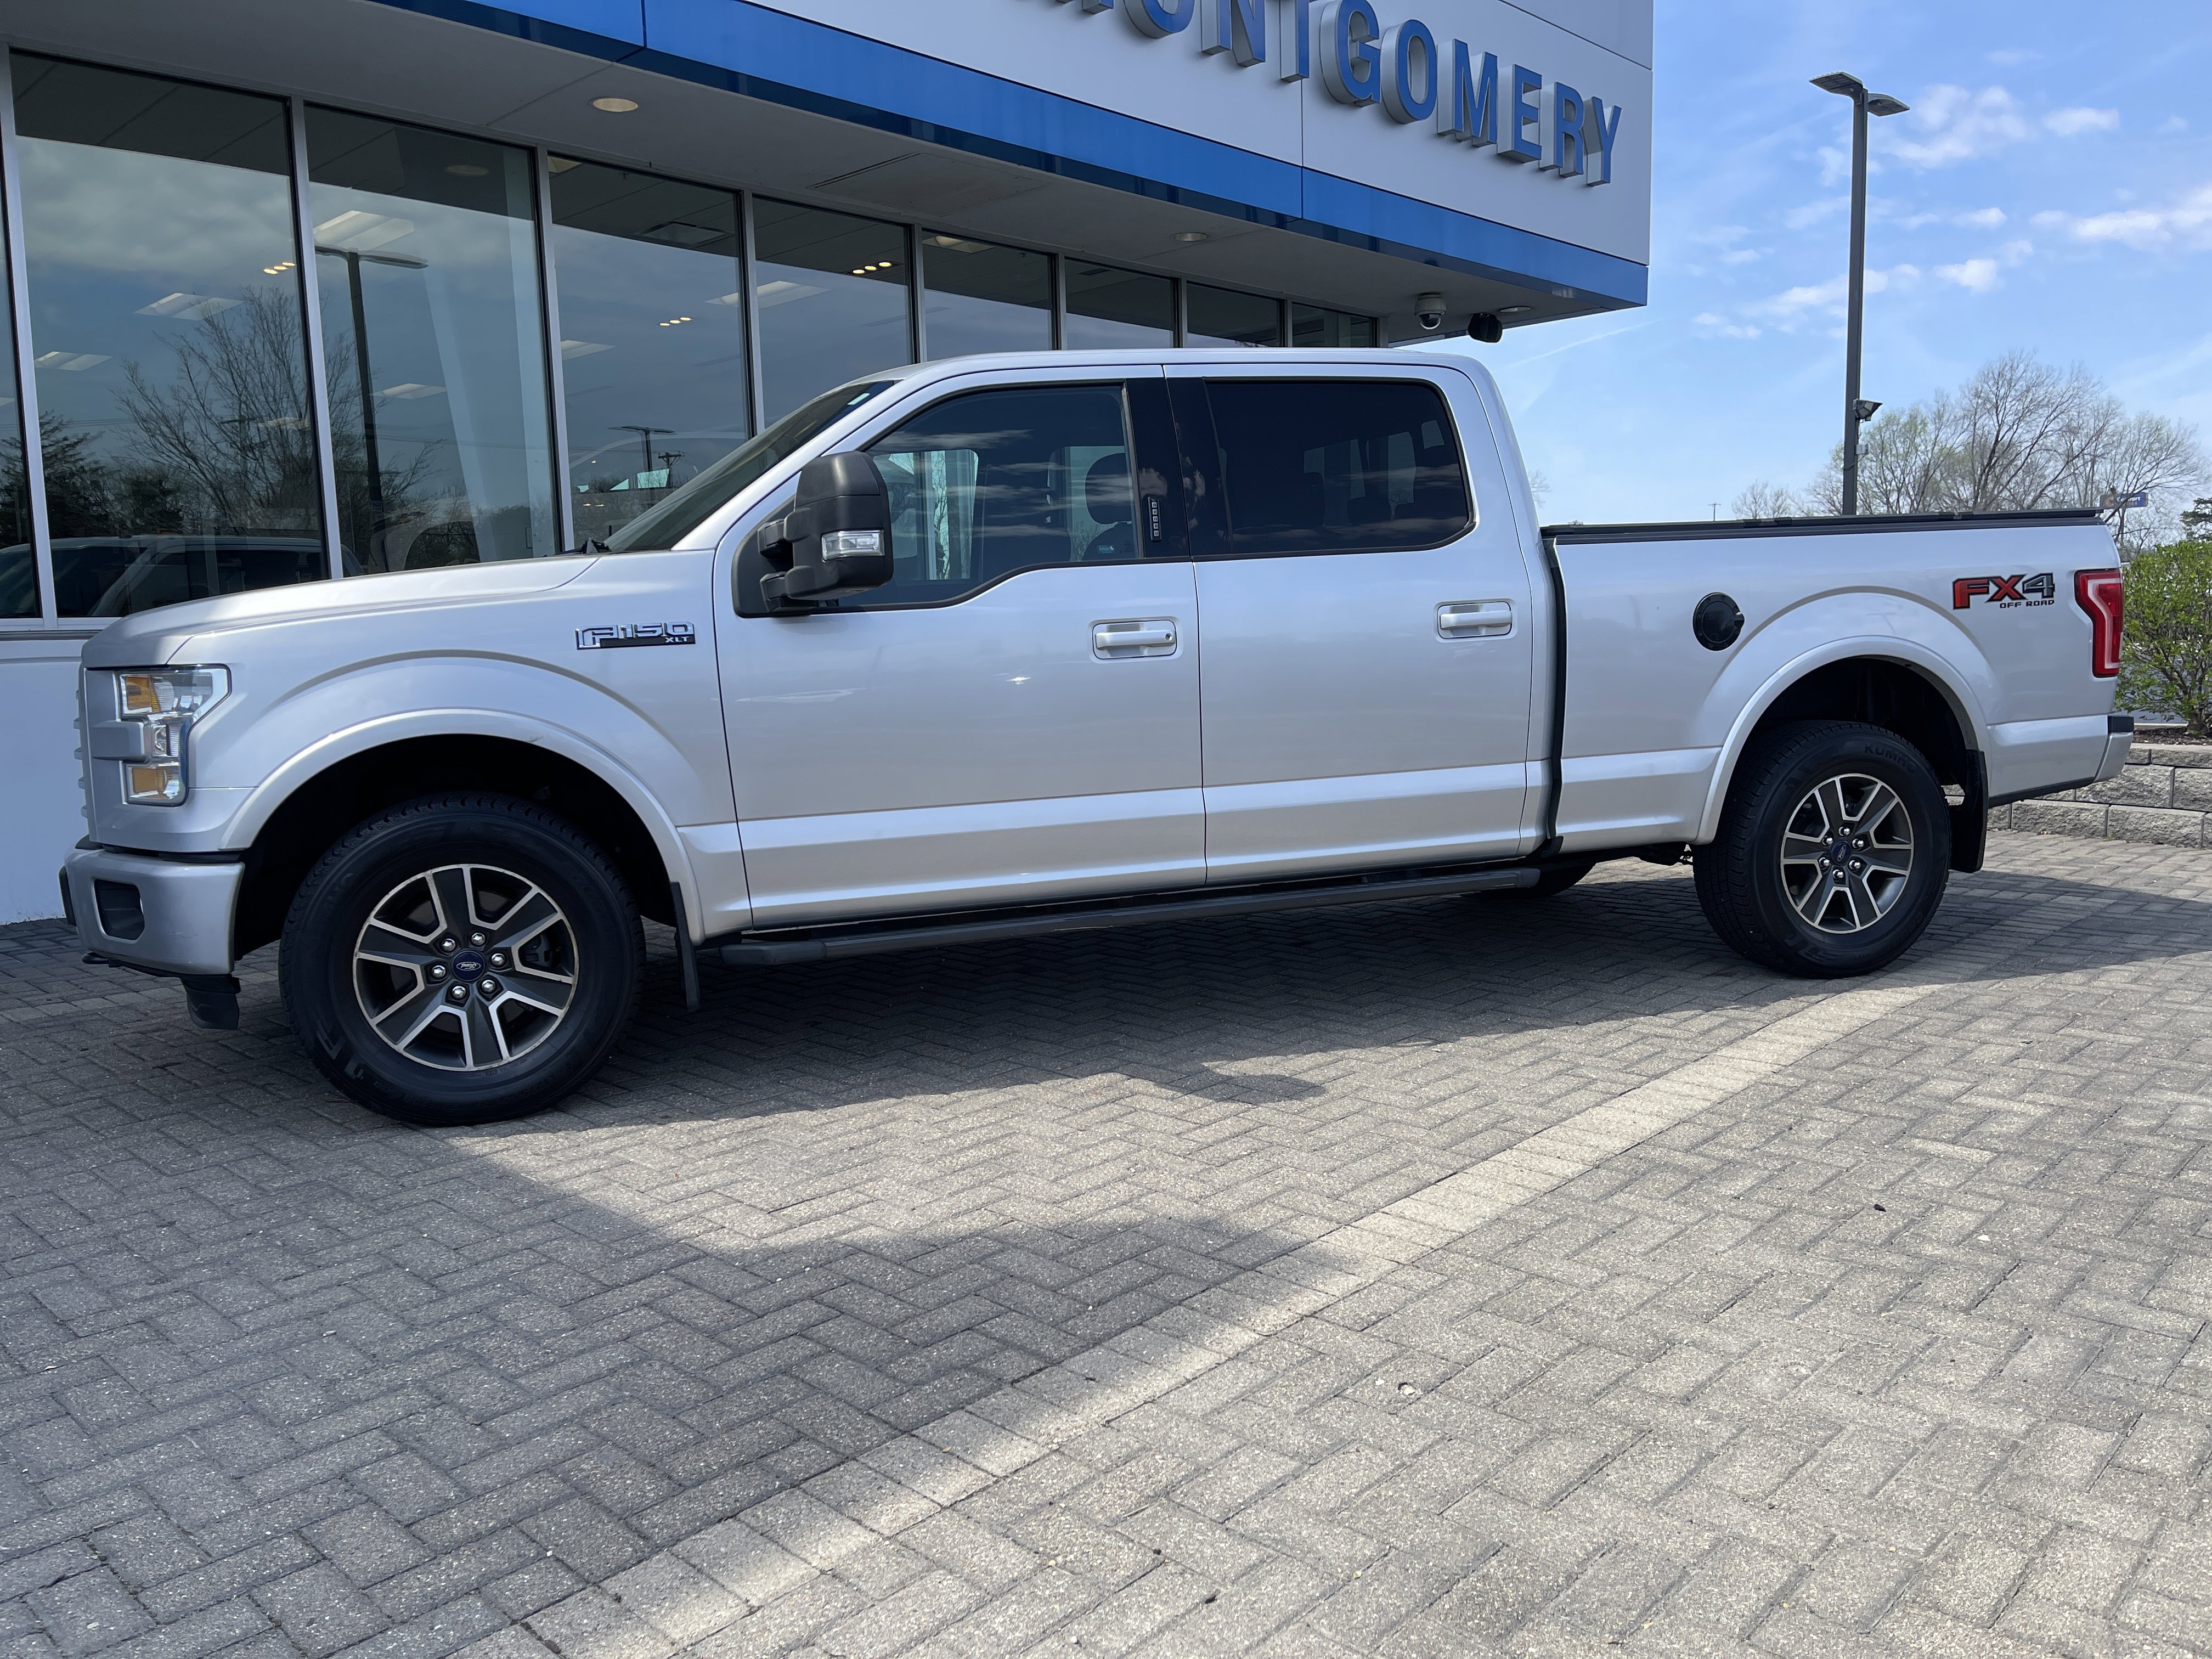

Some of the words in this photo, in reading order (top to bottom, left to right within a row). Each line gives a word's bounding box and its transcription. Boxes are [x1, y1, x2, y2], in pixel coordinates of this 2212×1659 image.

[1048, 0, 1622, 185] NTGOMERY
[1953, 572, 2055, 610] FX4
[1864, 745, 1916, 772] KUMHO
